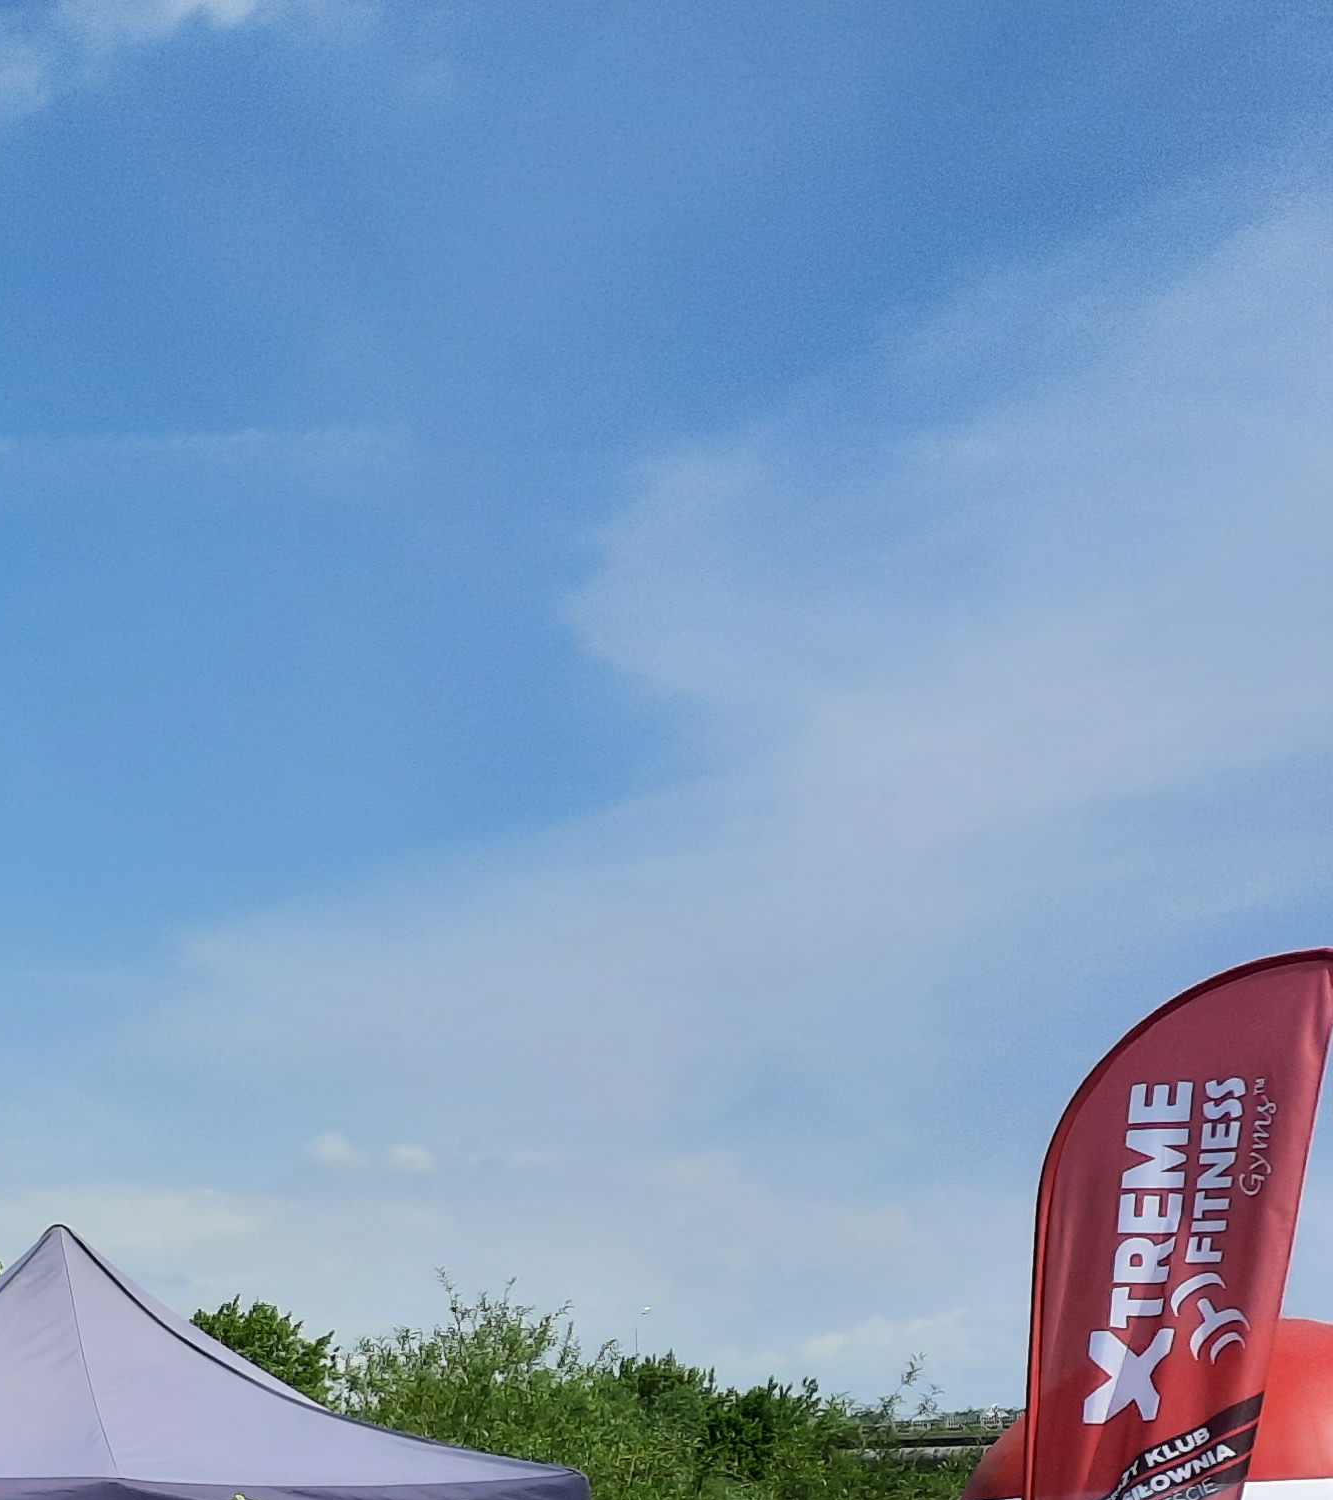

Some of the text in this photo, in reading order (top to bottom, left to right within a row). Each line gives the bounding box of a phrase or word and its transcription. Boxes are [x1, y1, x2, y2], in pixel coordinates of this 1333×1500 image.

[1186, 1076, 1247, 1264] FITNESS
[1239, 1094, 1277, 1197] Gyms
[1082, 1081, 1194, 1424] XTREME
[1144, 1426, 1211, 1468] KLUB
